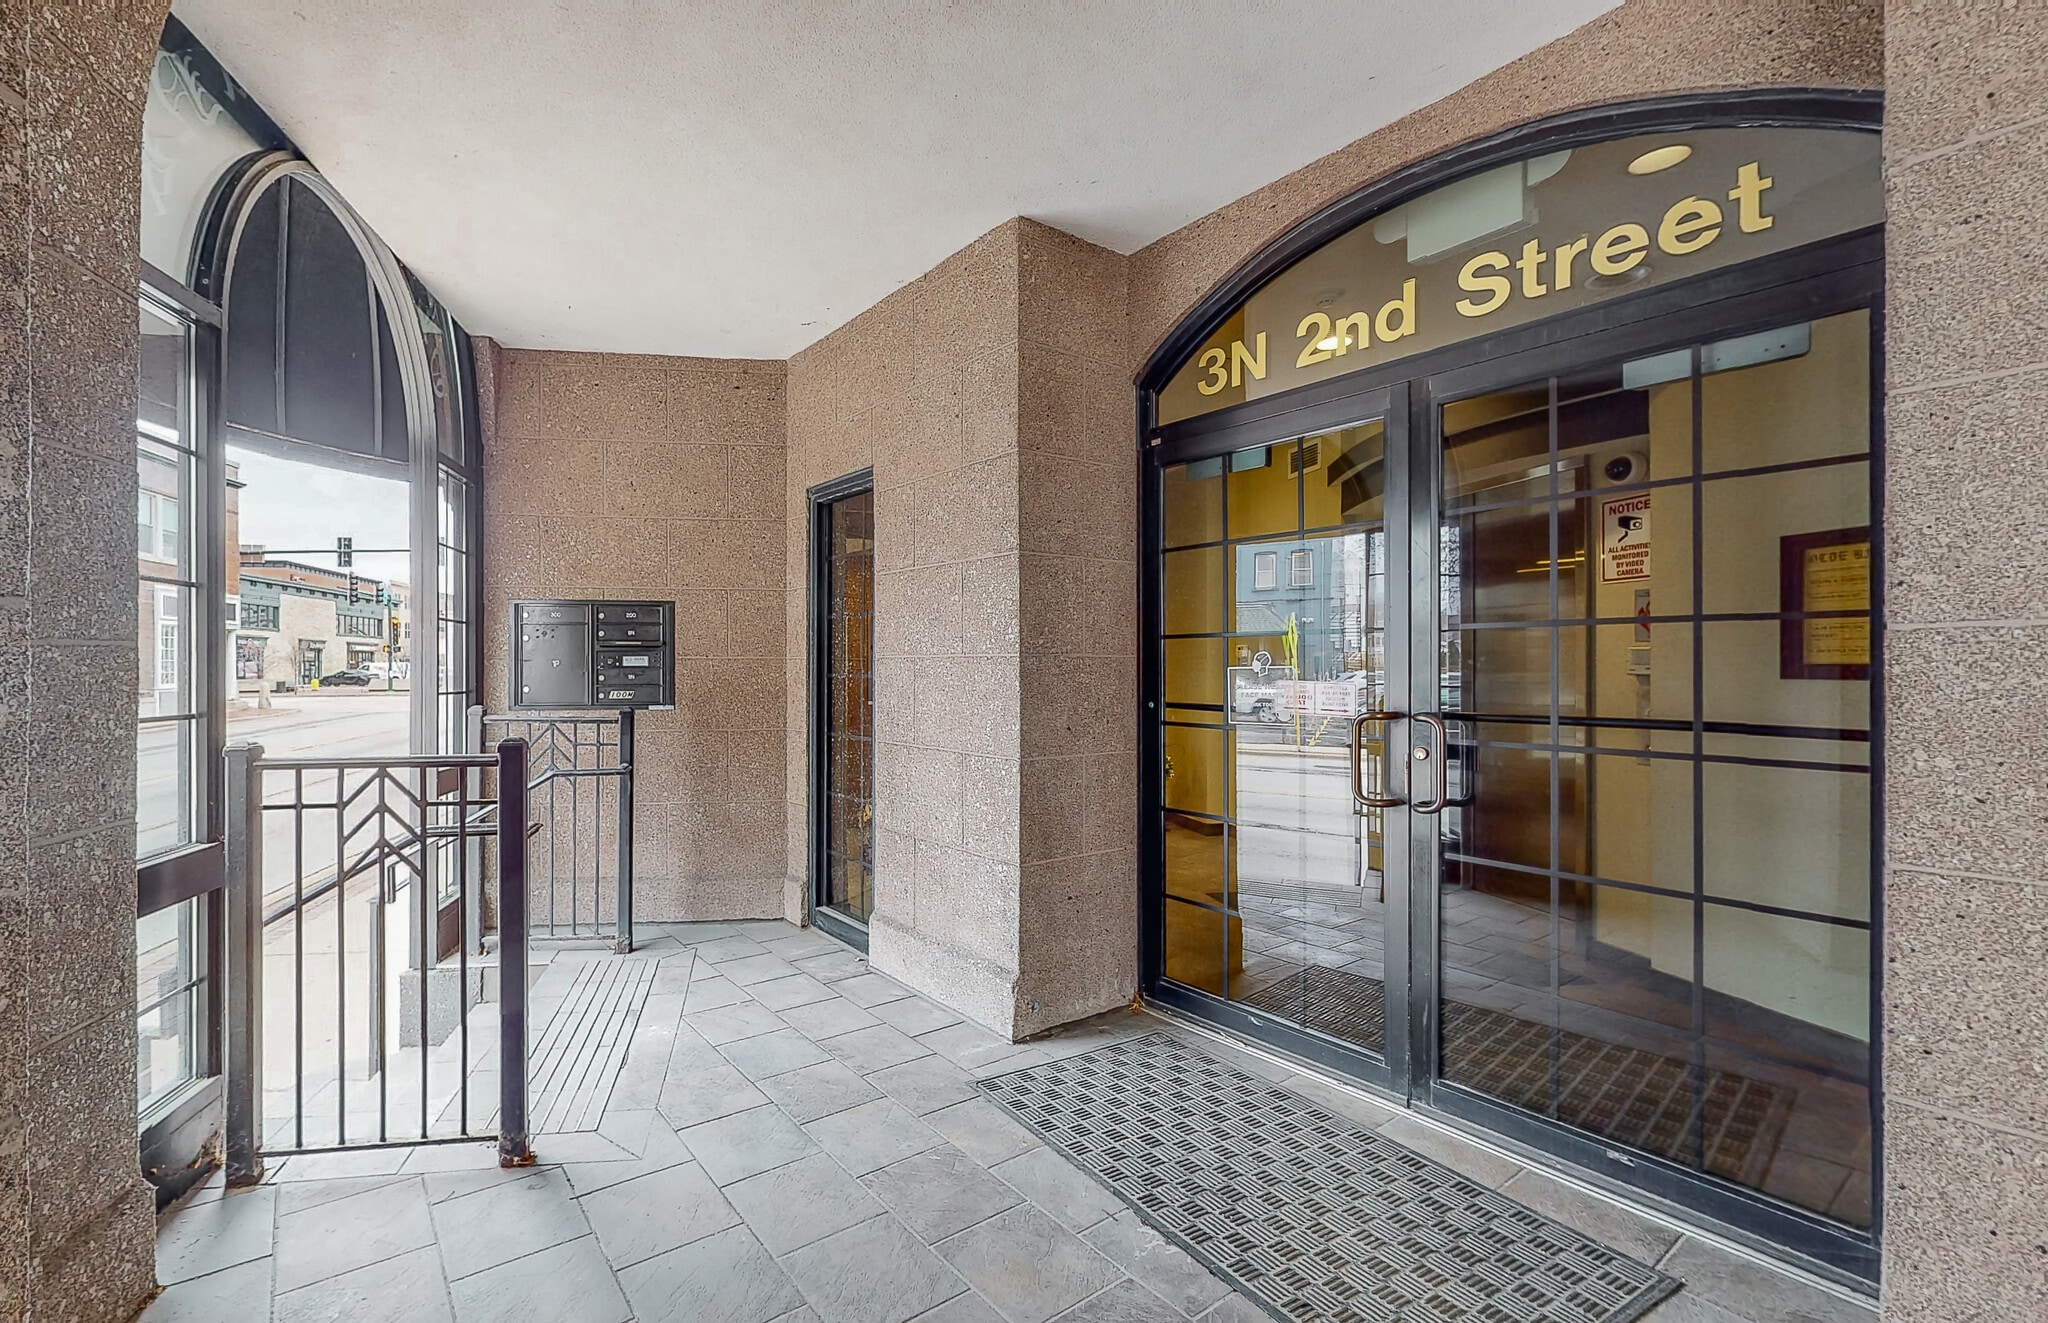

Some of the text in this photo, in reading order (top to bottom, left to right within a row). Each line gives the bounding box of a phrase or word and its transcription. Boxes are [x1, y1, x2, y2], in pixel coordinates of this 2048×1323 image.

[1196, 160, 1775, 396] 3N 2nd Street
[1609, 500, 1651, 516] NOTICE
[1608, 543, 1651, 554] ALL ACTIVITIE
[1612, 552, 1649, 561] MONITORED
[1625, 560, 1644, 568] VIDEO
[1617, 569, 1644, 577] CAMERA
